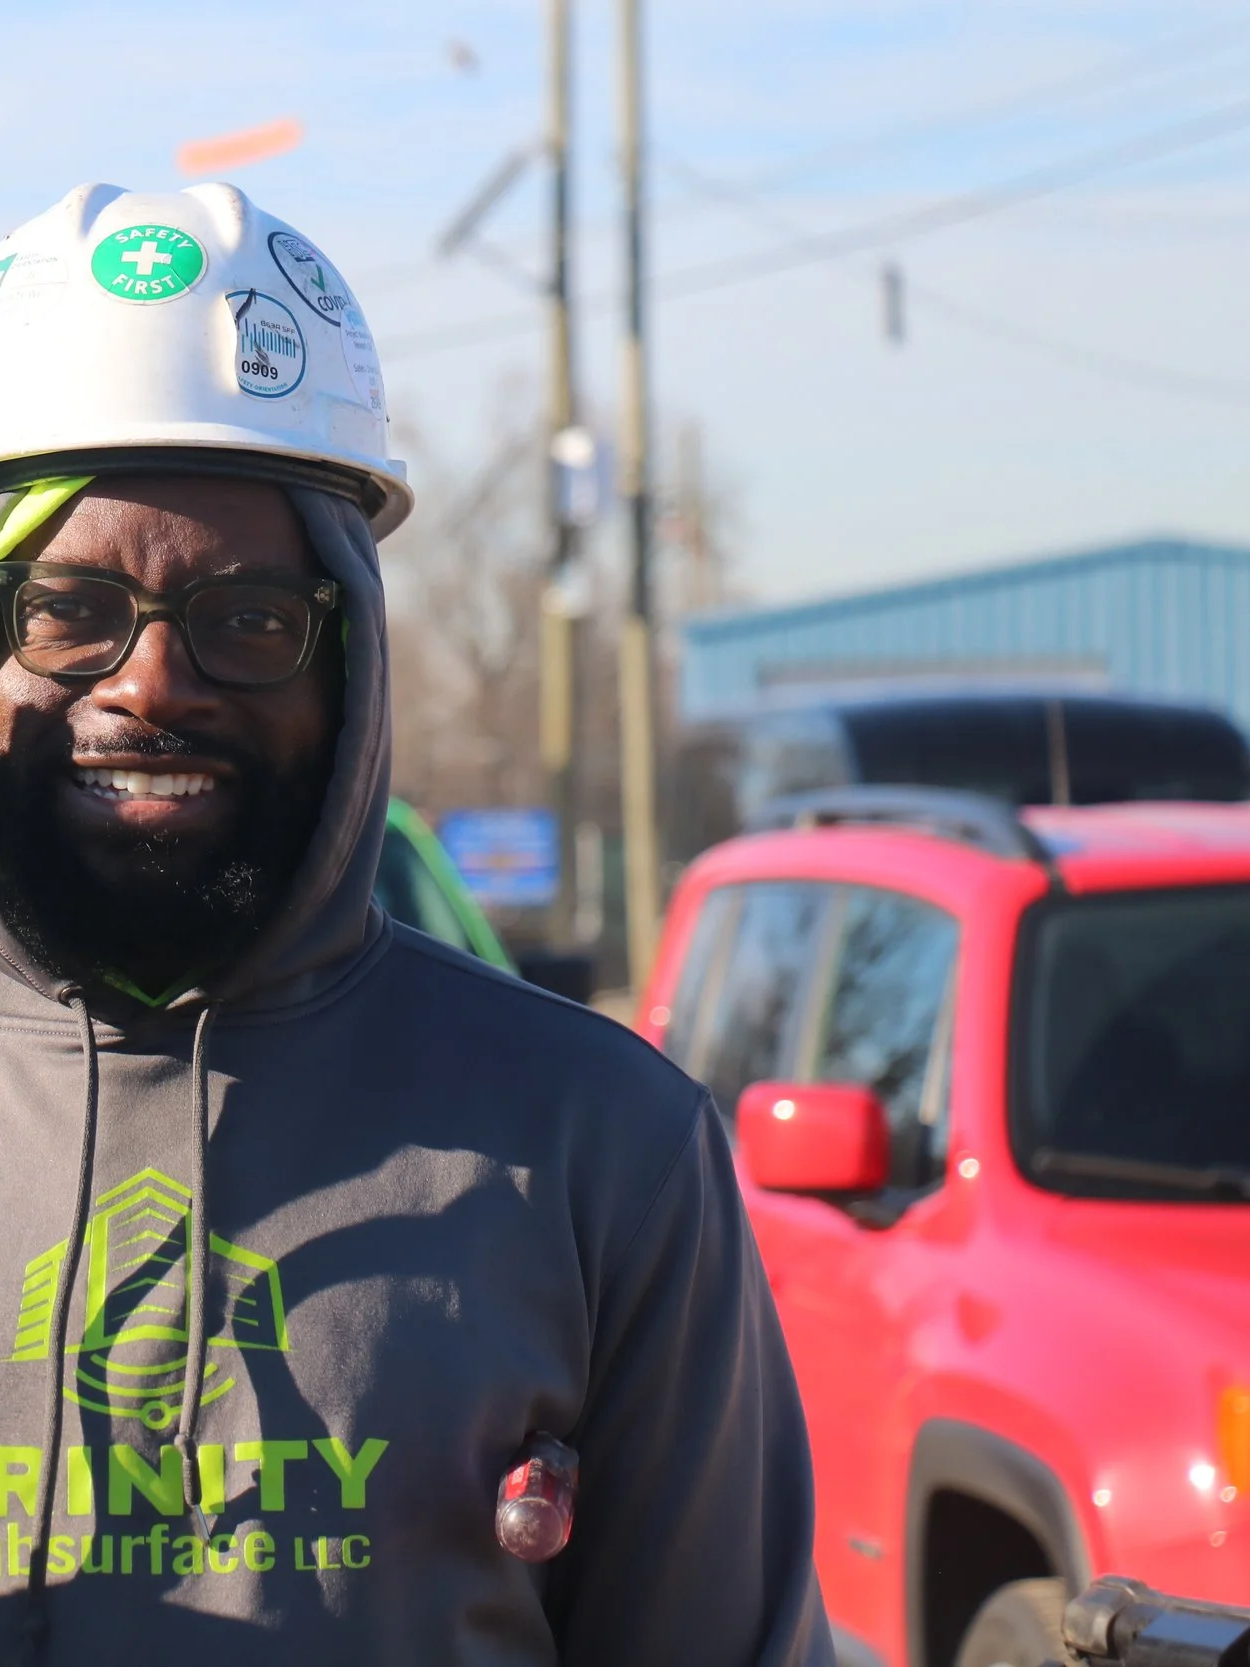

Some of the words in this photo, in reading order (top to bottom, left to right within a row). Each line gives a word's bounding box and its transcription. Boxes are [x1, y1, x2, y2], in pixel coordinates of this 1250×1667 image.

[115, 227, 193, 248] SAFETY
[111, 273, 175, 295] FIRST
[241, 360, 279, 380] 0909
[294, 1534, 372, 1571] LLC
